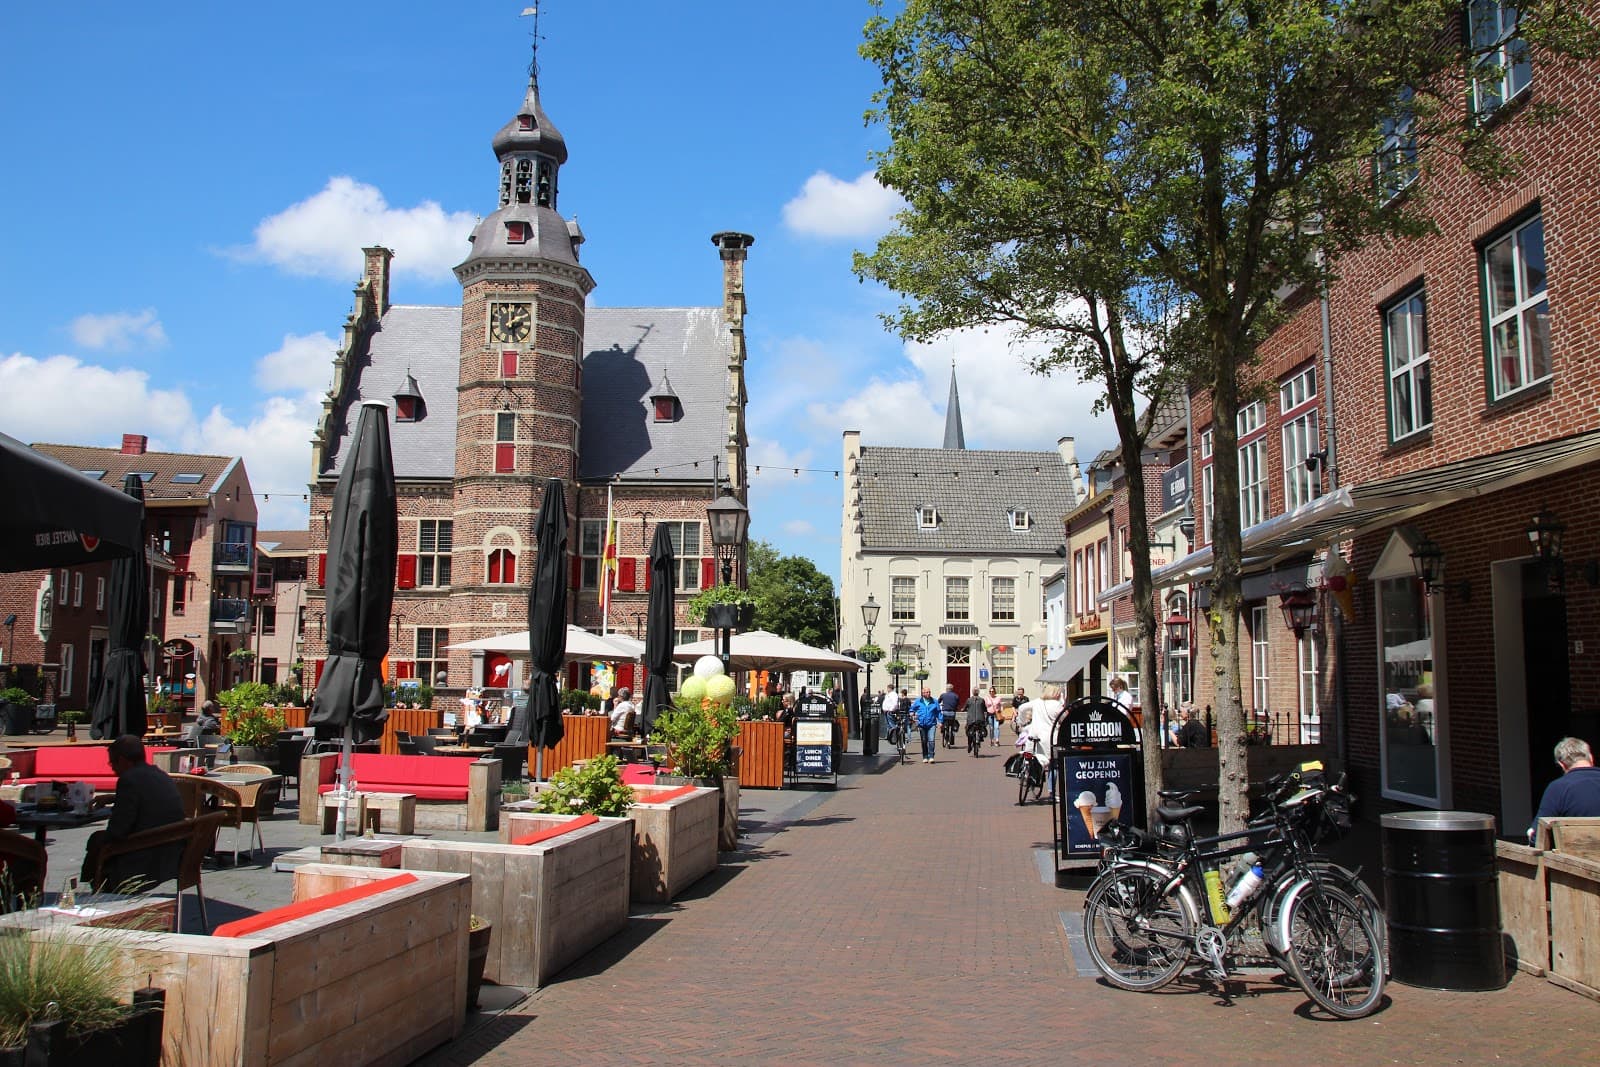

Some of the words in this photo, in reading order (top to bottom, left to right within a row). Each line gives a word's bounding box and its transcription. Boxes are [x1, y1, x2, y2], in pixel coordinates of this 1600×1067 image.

[1070, 723, 1085, 738] DE
[1086, 722, 1122, 737] KROON
[1078, 761, 1094, 770] WIJ
[1097, 761, 1116, 769] ZIJN
[1075, 770, 1121, 779] GEOPEND!
